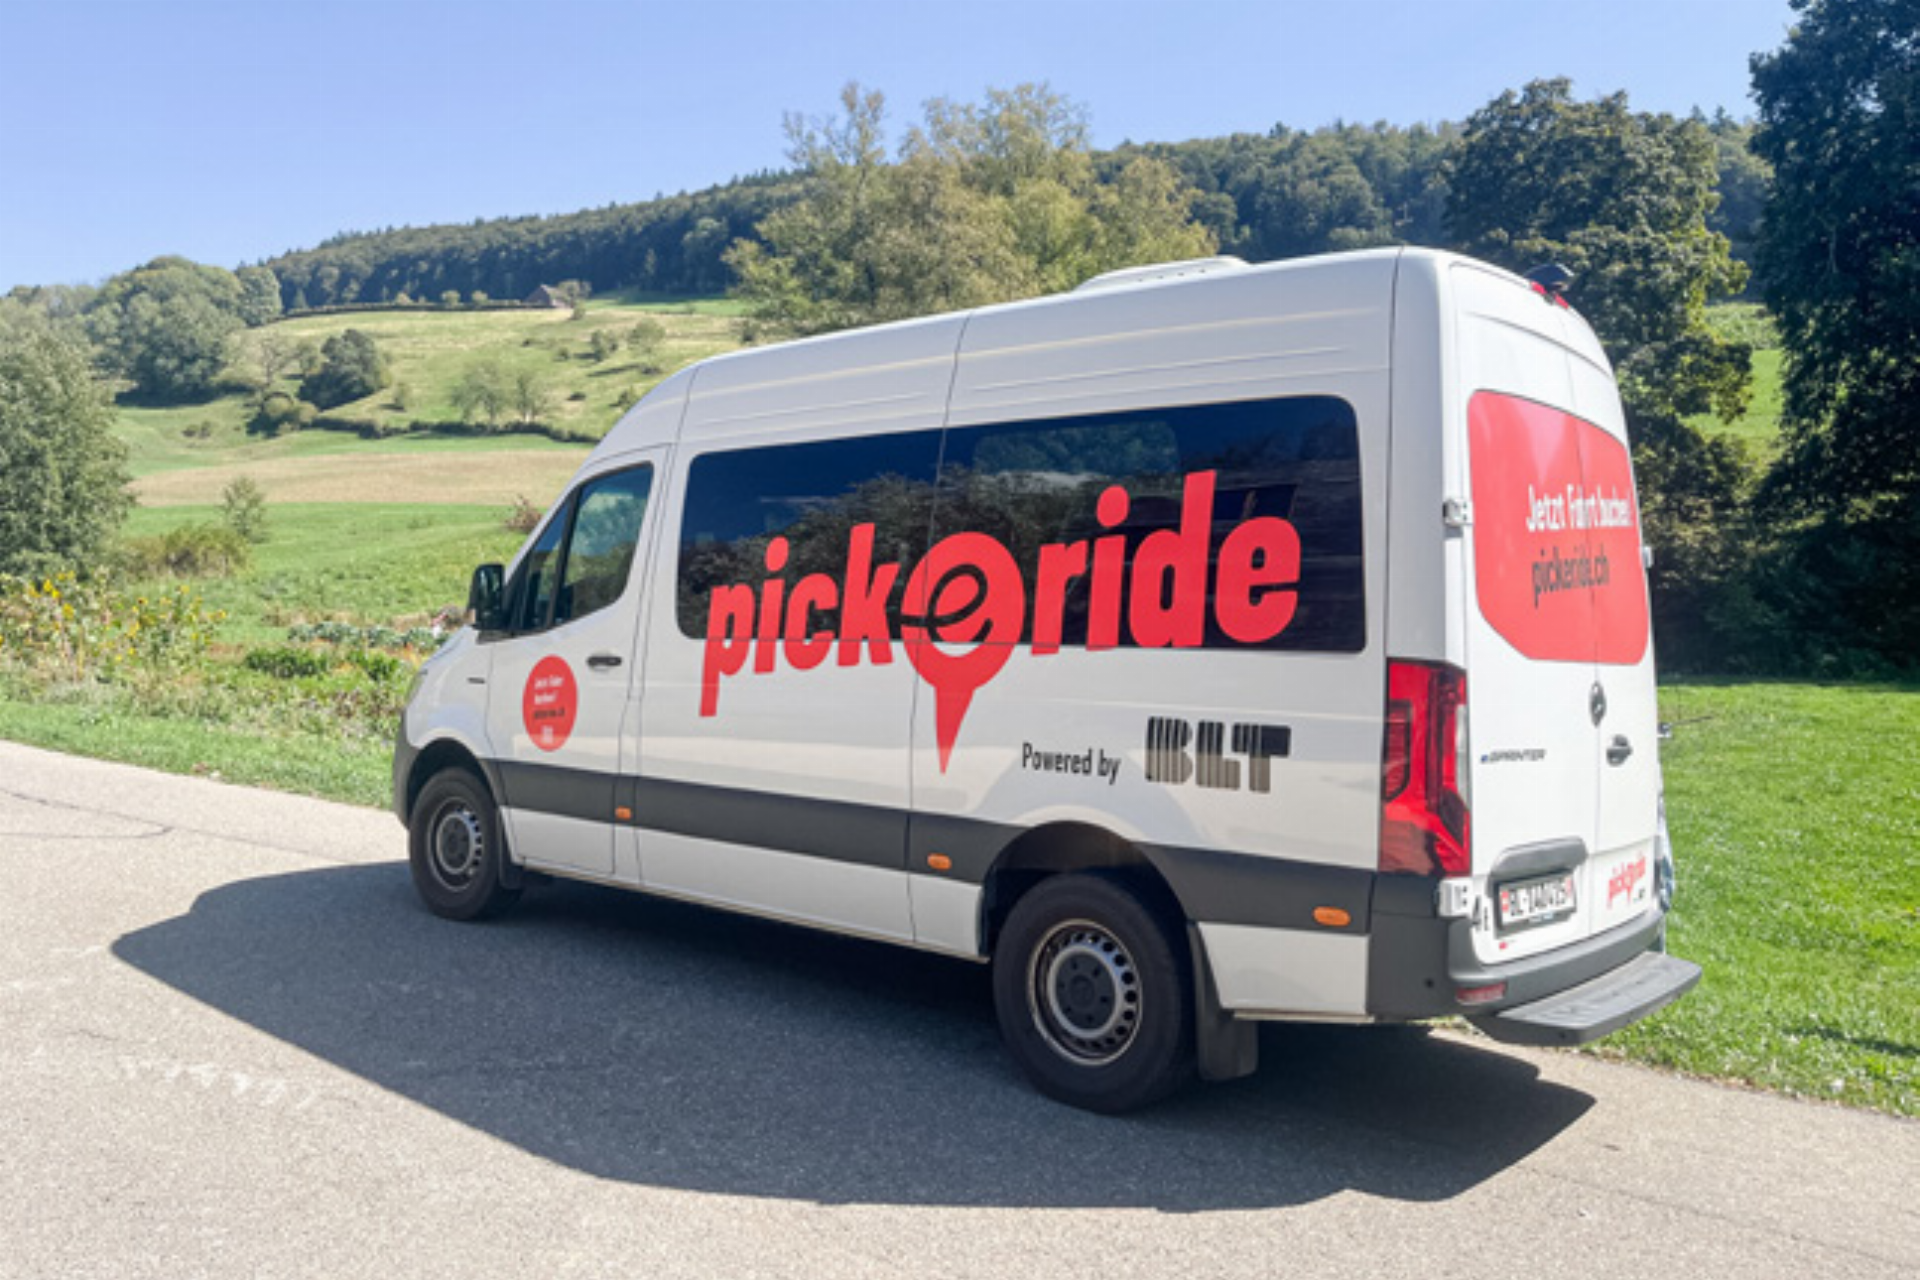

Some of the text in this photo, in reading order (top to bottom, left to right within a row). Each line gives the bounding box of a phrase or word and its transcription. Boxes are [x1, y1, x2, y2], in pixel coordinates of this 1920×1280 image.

[1525, 483, 1565, 532] Jetzt
[1021, 742, 1121, 785] Powered by
[1144, 716, 1291, 794] BLT
